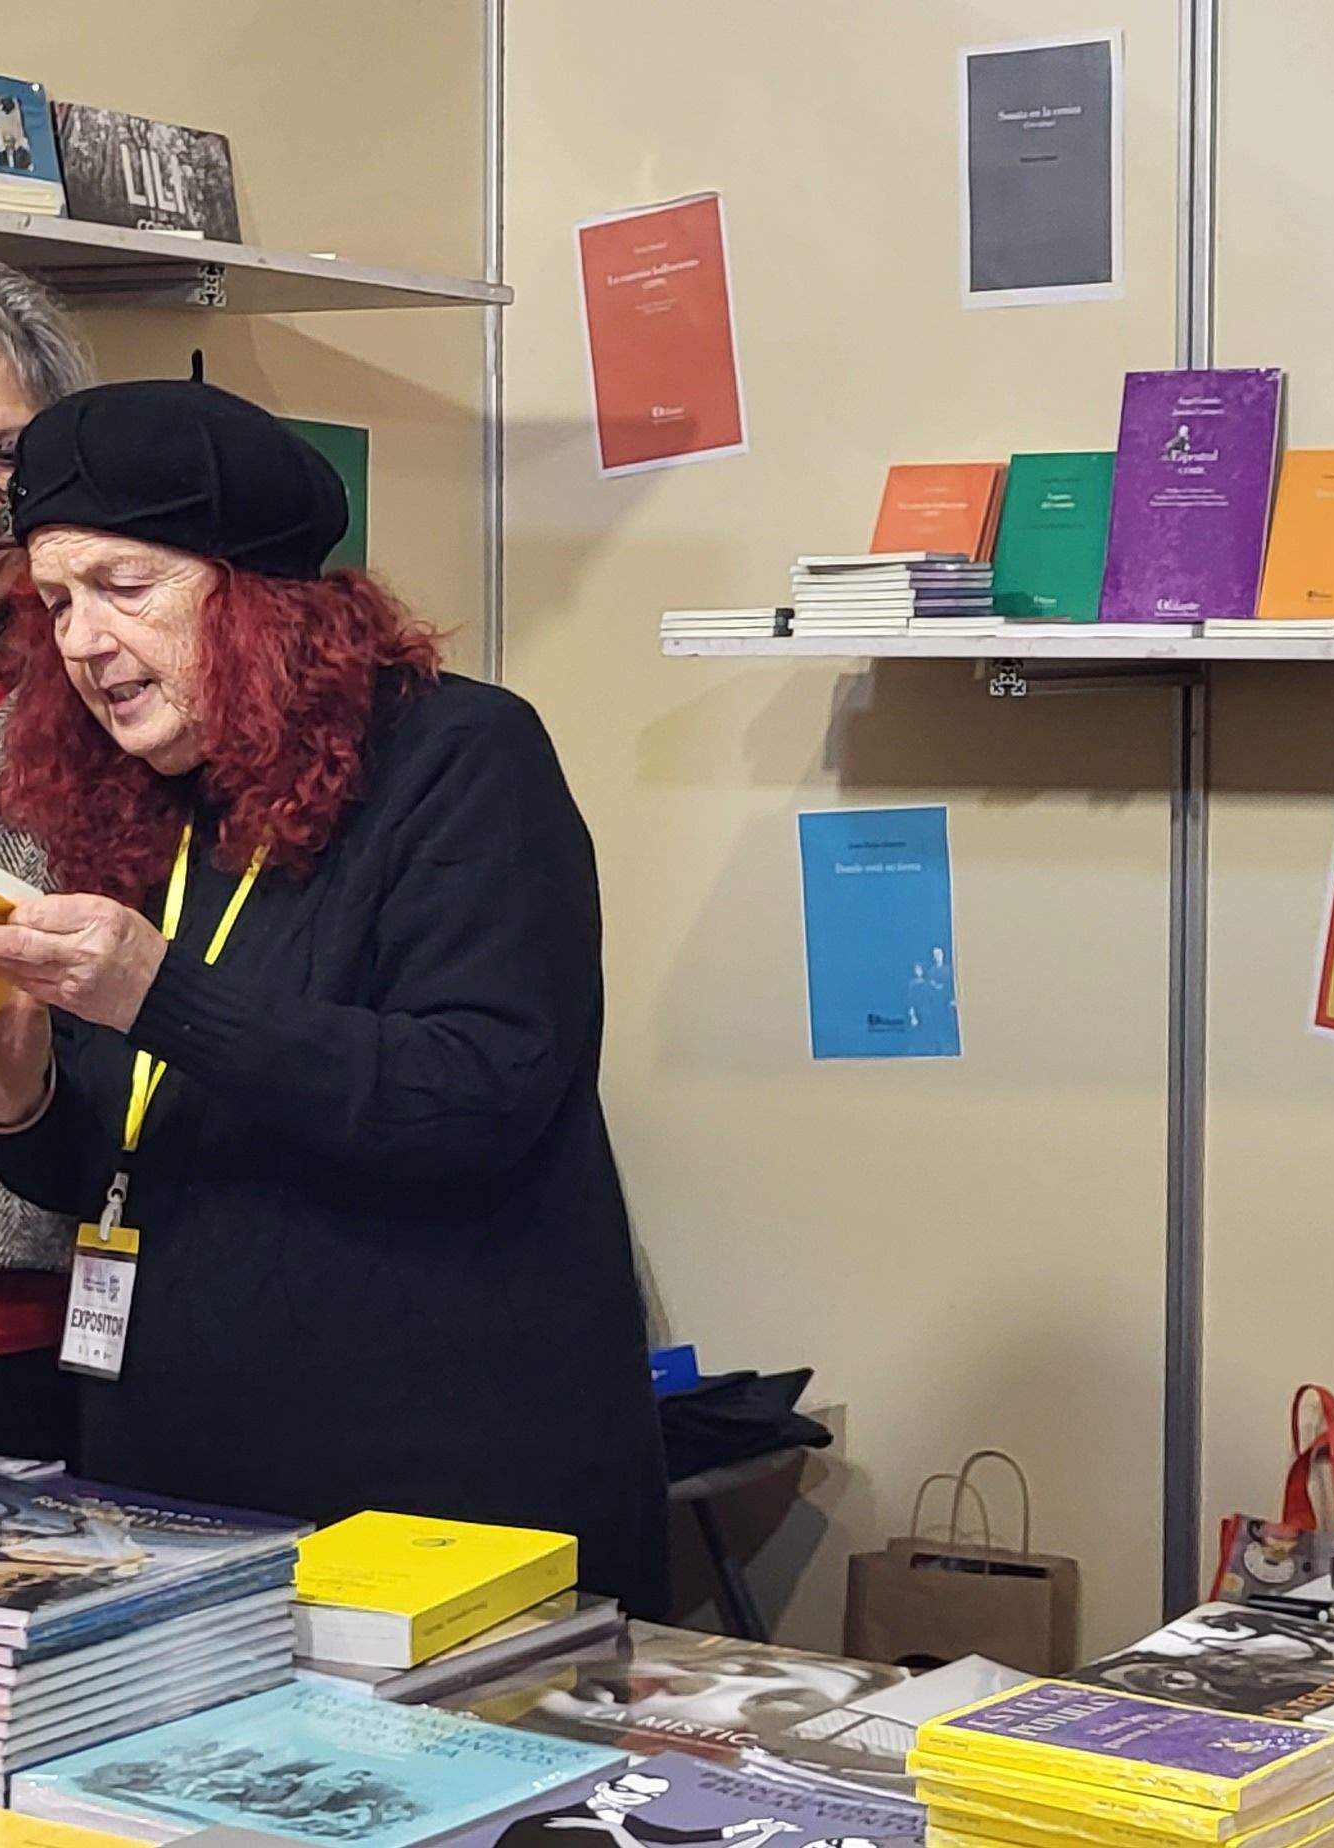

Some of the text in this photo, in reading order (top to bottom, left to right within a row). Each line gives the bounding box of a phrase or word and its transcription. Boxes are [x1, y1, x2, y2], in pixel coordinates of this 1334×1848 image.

[71, 1307, 125, 1338] EXPOSITOR
[584, 1704, 759, 1747] LA MISTIC
